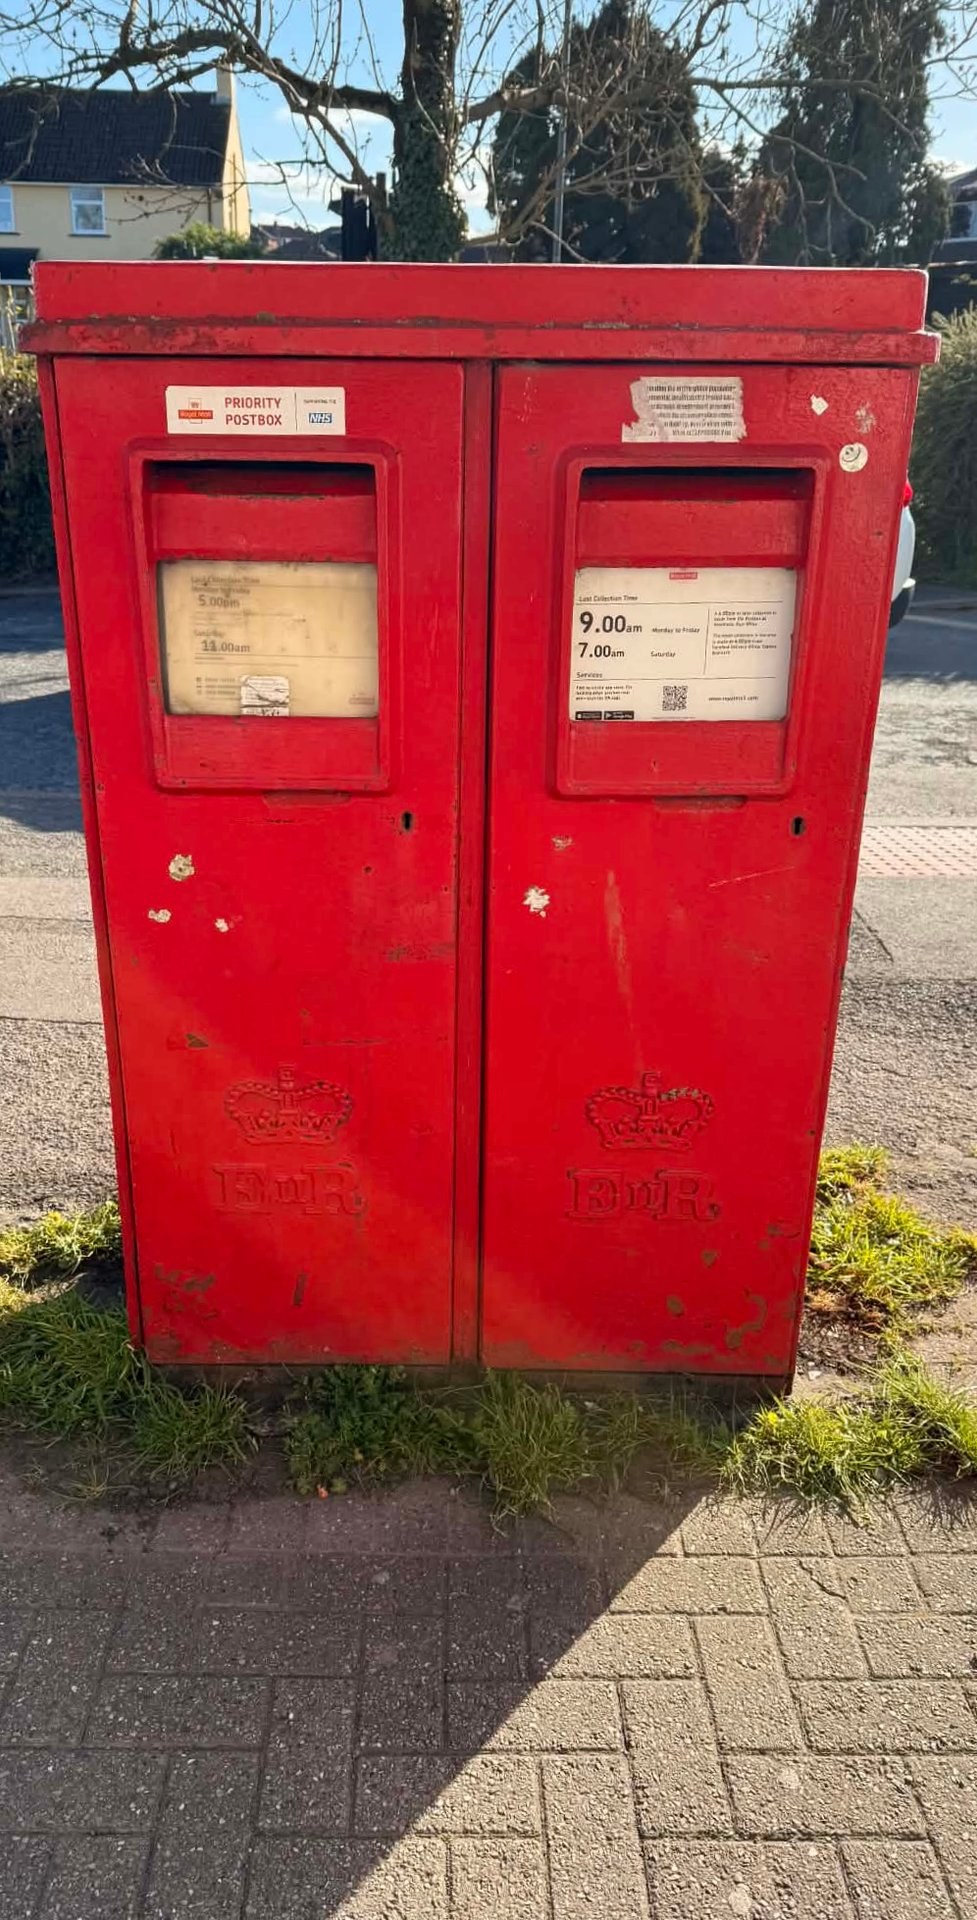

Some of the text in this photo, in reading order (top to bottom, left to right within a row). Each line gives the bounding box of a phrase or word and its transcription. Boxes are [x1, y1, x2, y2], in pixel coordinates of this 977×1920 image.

[224, 397, 282, 409] PRIORITY
[225, 414, 282, 426] POSTBOX
[310, 413, 332, 423] NHS
[198, 594, 240, 608] 5.00pm
[579, 611, 643, 633] 9.00am
[201, 640, 250, 653] 11.00am
[578, 642, 625, 658] 7.00am
[650, 650, 676, 658] Saturday
